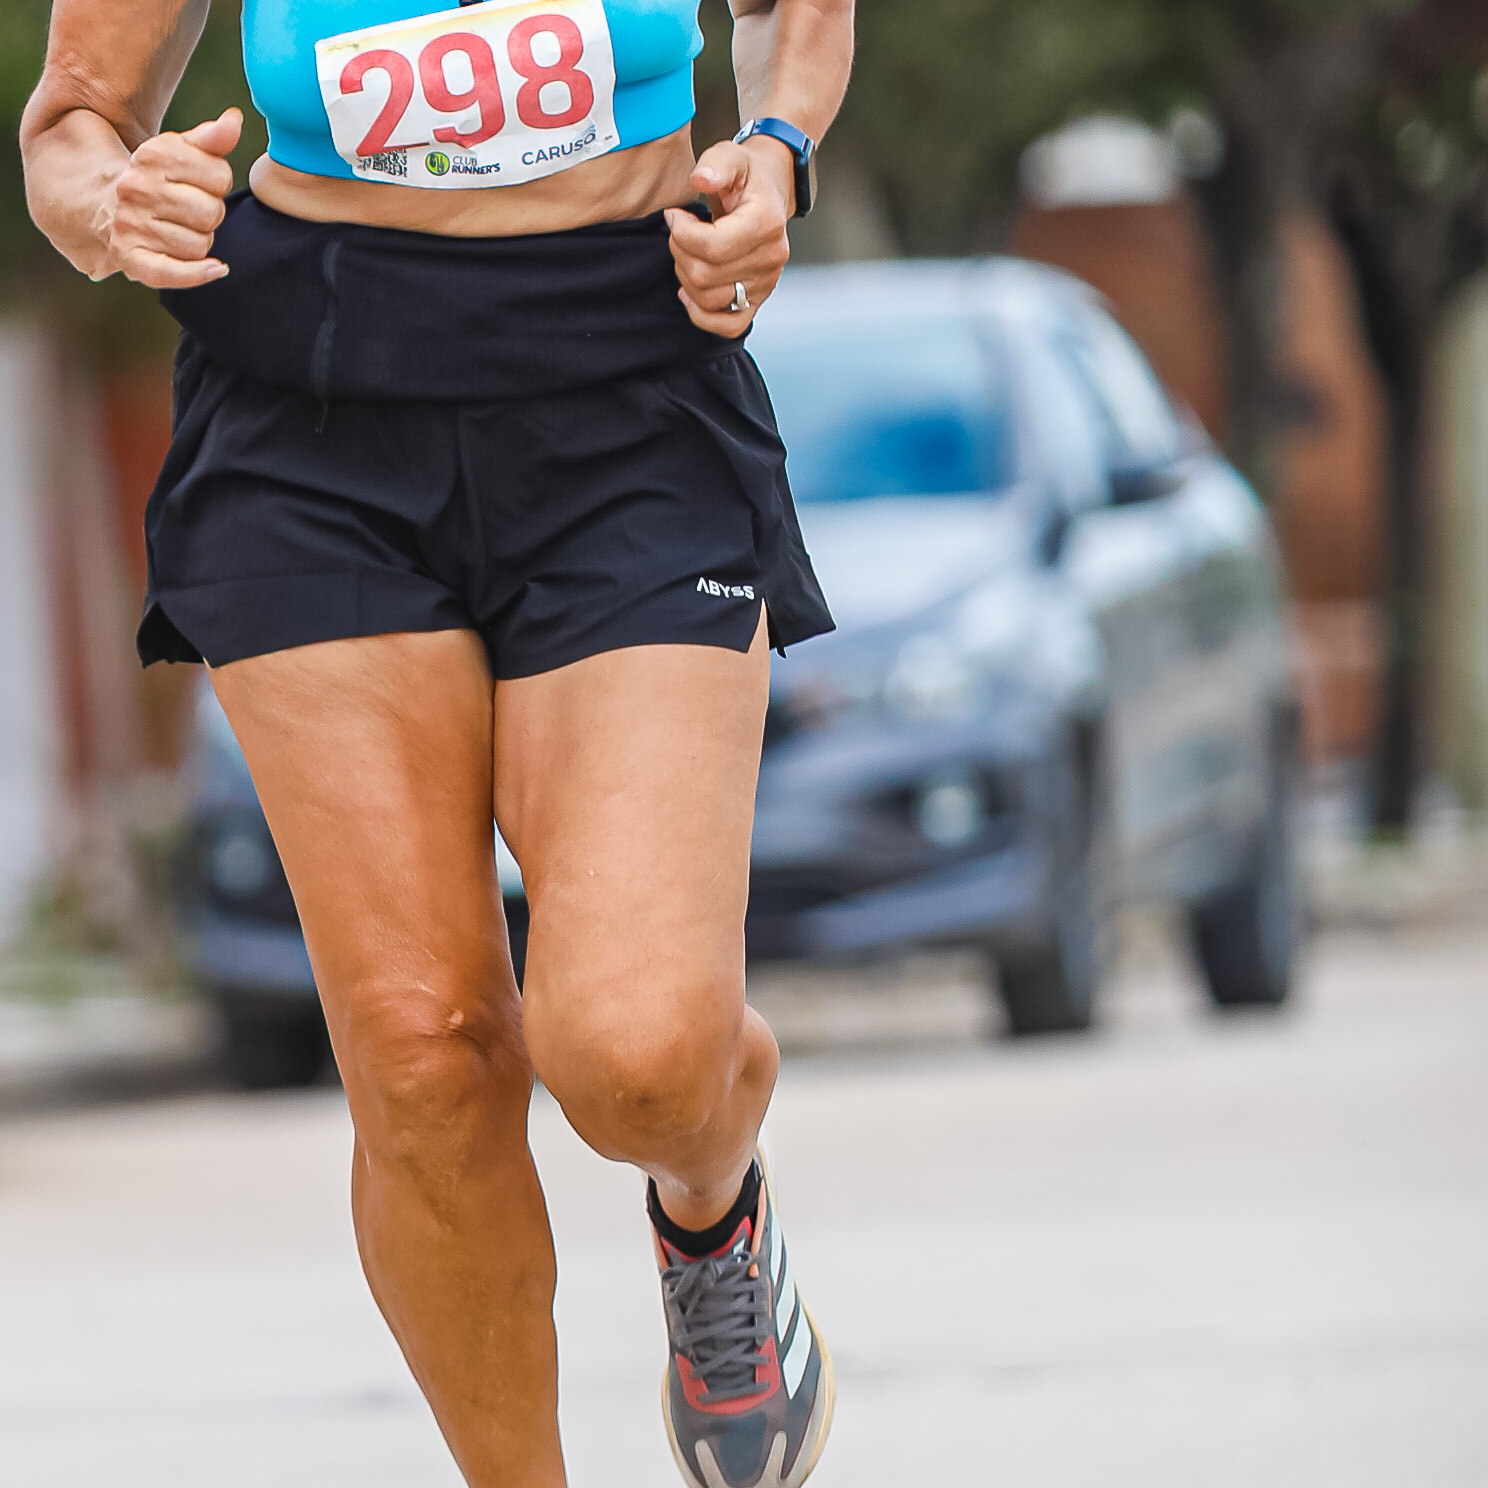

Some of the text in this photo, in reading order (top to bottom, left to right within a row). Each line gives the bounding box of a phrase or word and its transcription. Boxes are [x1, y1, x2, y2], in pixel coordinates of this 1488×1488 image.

[339, 14, 595, 158] 298
[452, 155, 478, 167] CLUB
[521, 132, 596, 165] CARUSO
[451, 162, 501, 175] RUNNER'S
[696, 576, 755, 601] ABYSS
